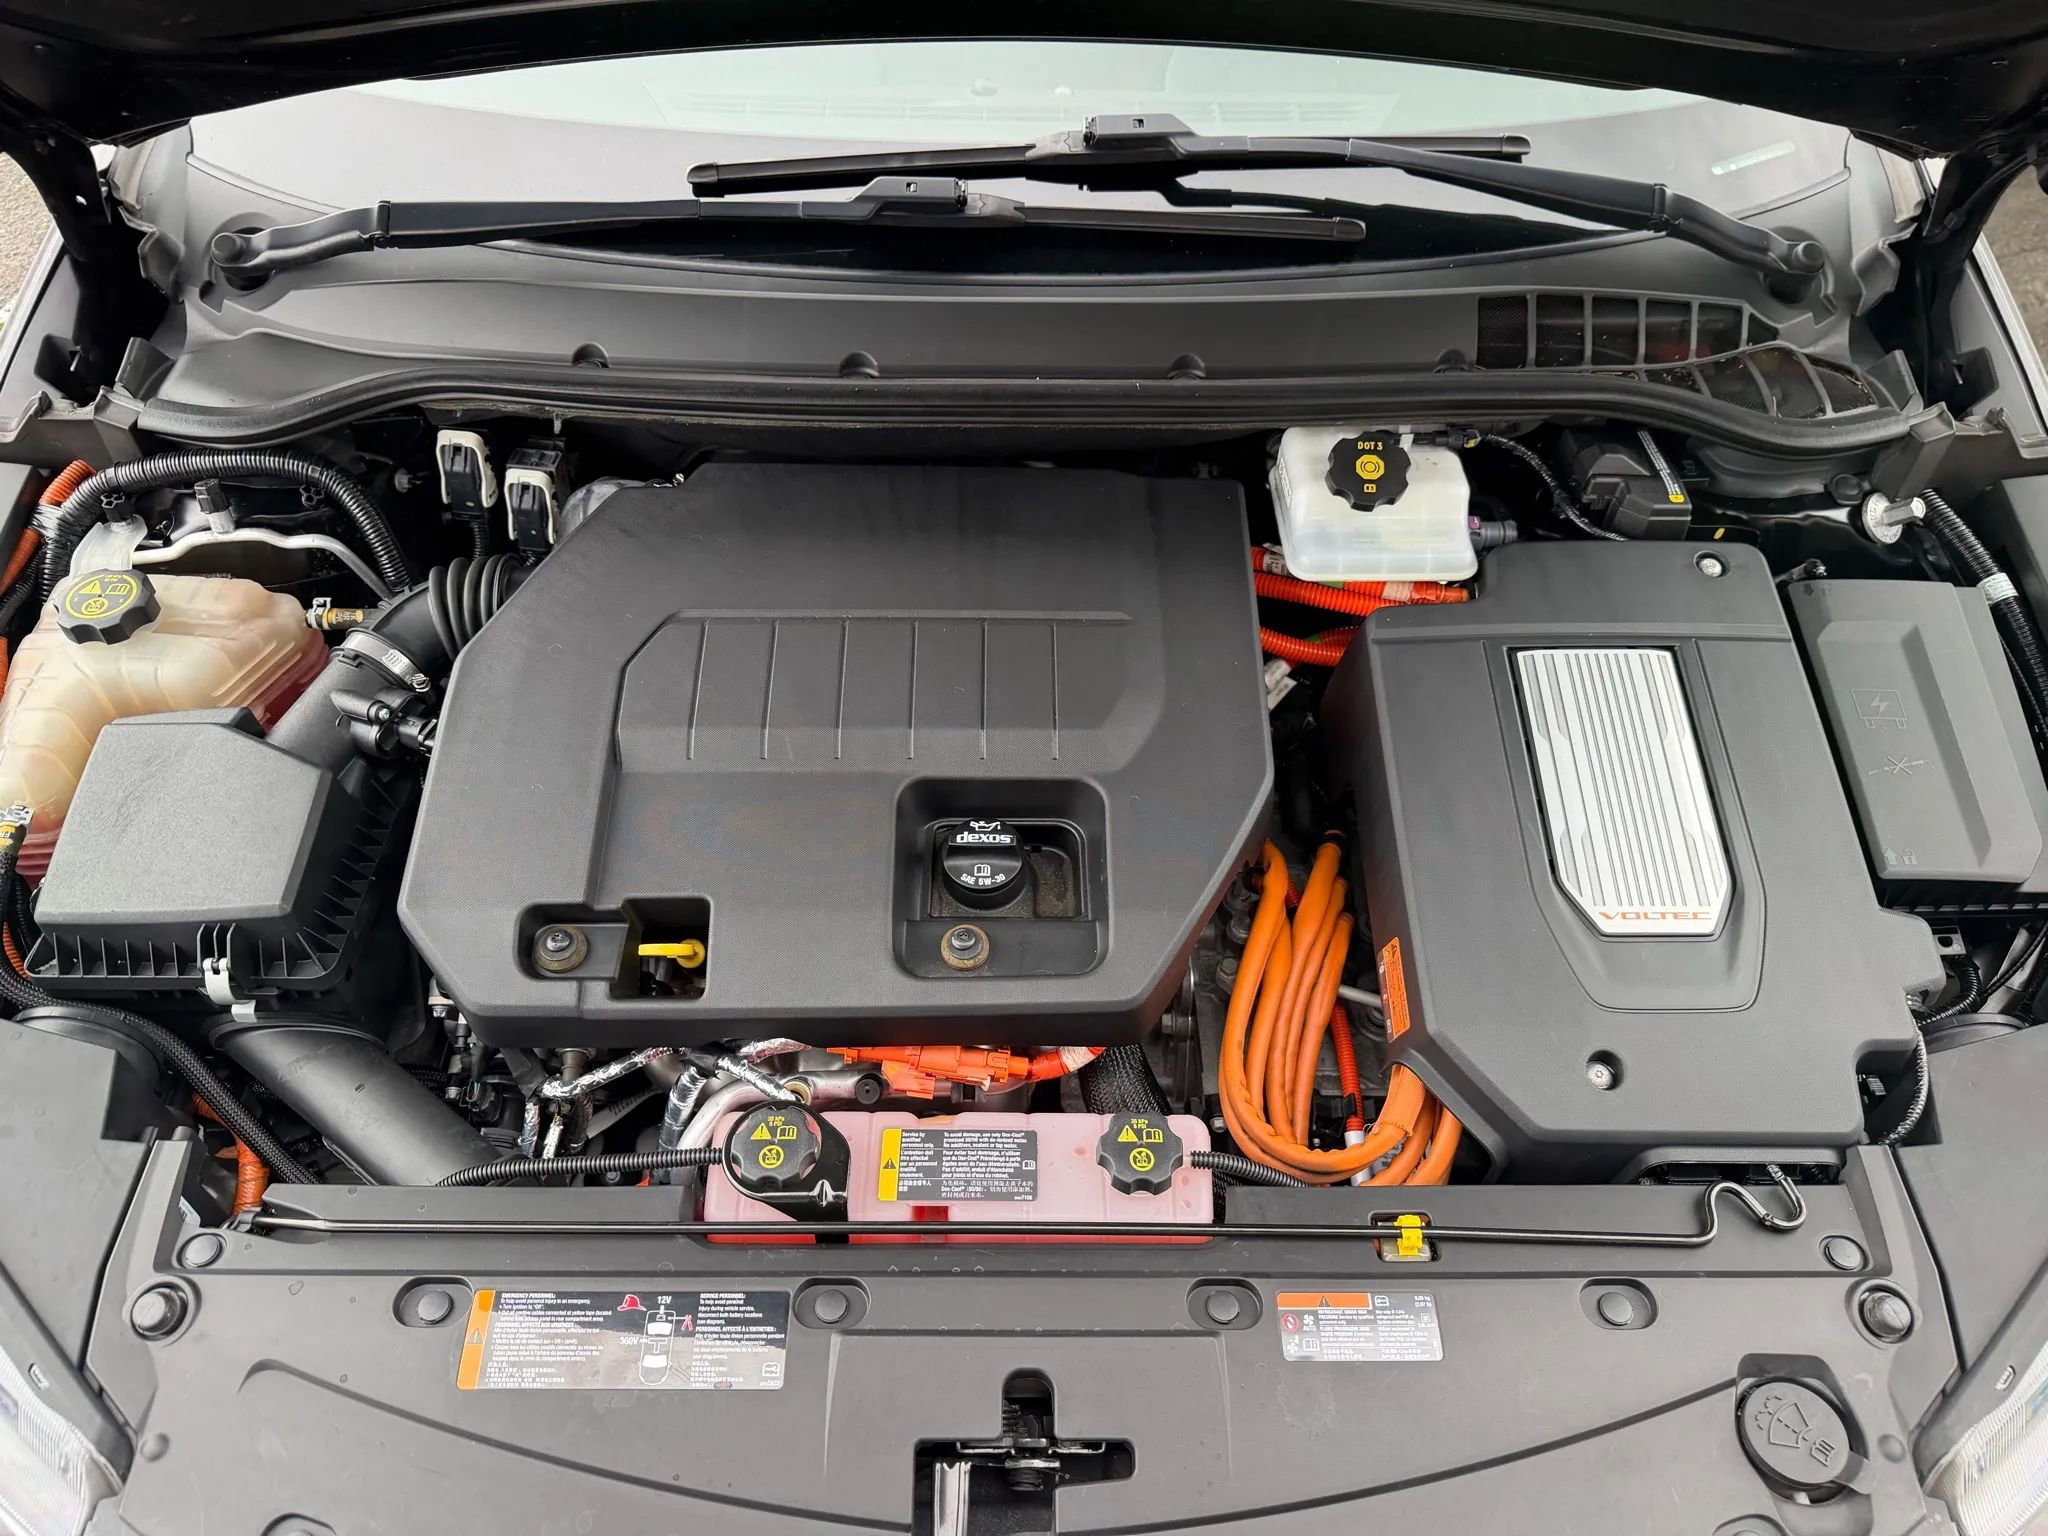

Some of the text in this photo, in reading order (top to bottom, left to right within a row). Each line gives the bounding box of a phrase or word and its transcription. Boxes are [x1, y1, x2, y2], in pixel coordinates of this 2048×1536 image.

[1357, 441, 1383, 451] DOT 3
[956, 832, 1012, 843] dexos
[960, 874, 1006, 885] SAE 5W-30
[1598, 911, 1712, 920] VOLTEC
[657, 1296, 672, 1304] 12V
[619, 1337, 639, 1345] 360V
